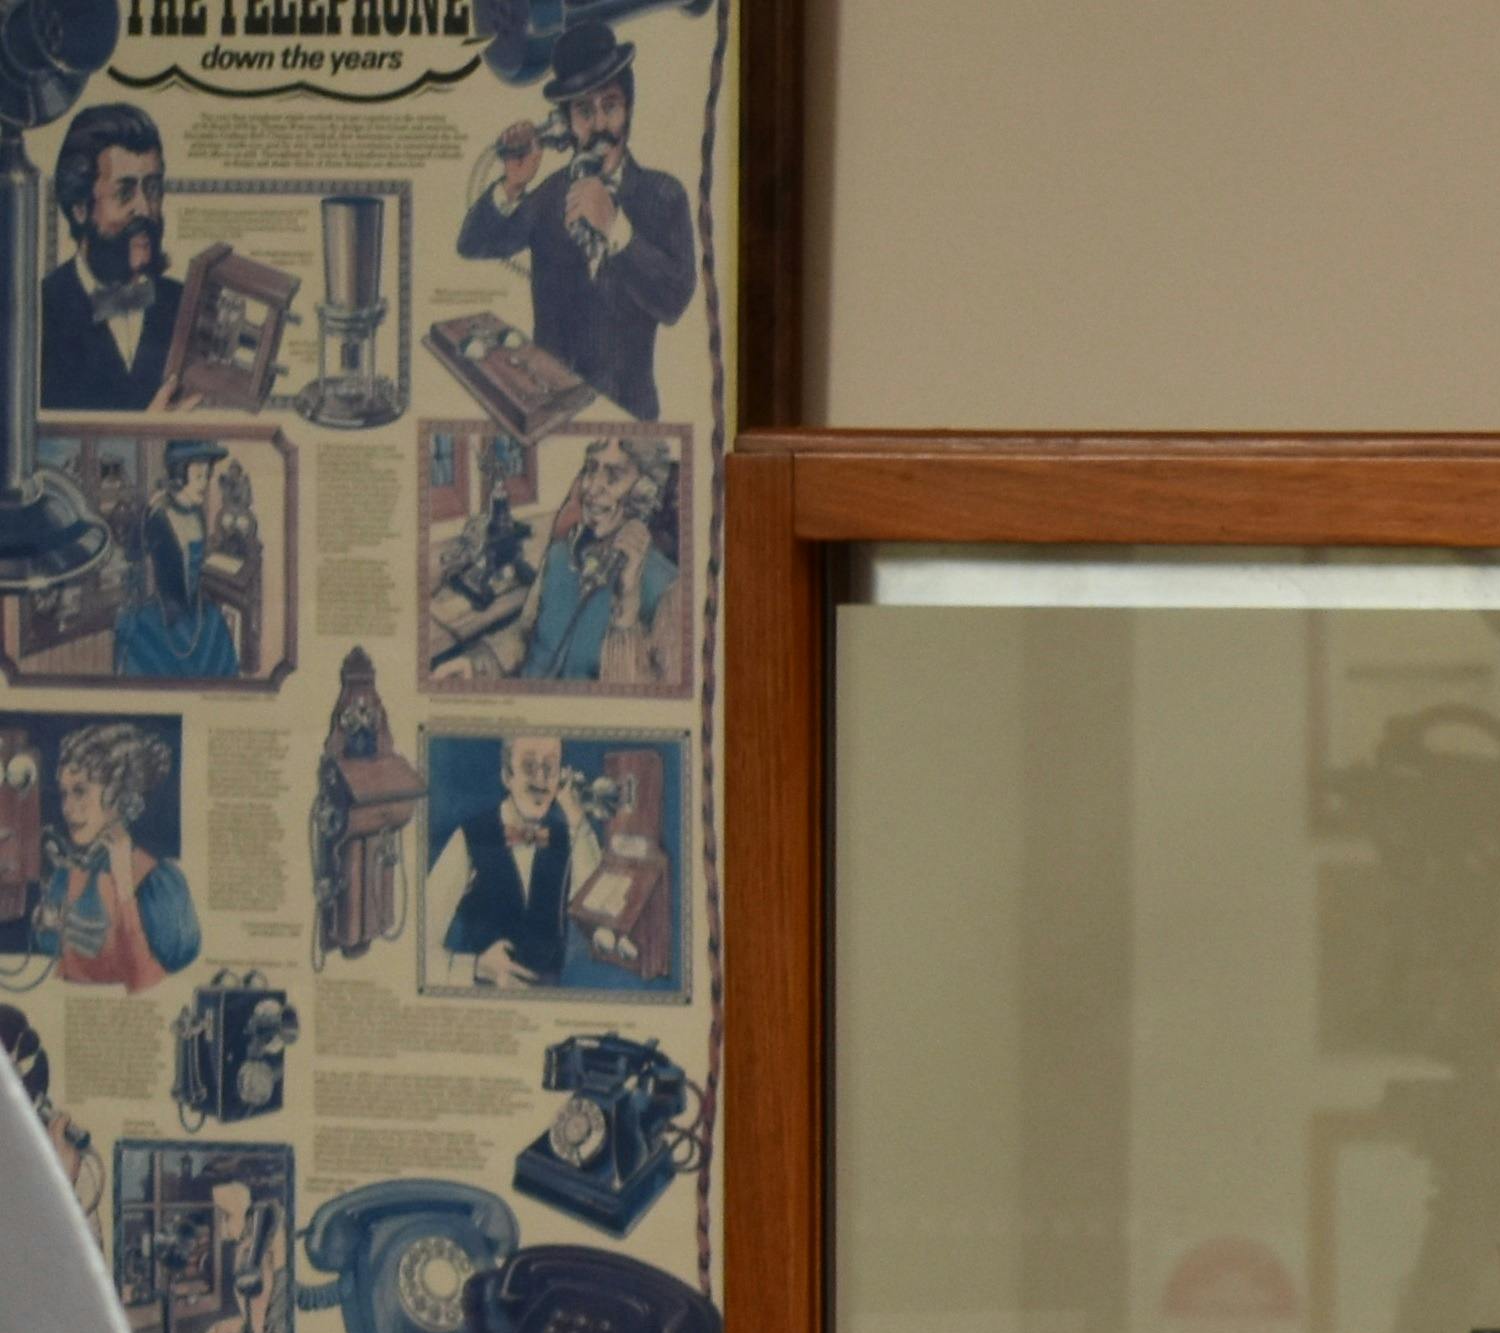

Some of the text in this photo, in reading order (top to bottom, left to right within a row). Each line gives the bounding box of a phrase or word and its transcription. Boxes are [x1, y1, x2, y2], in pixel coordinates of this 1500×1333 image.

[200, 43, 403, 76] down the years
